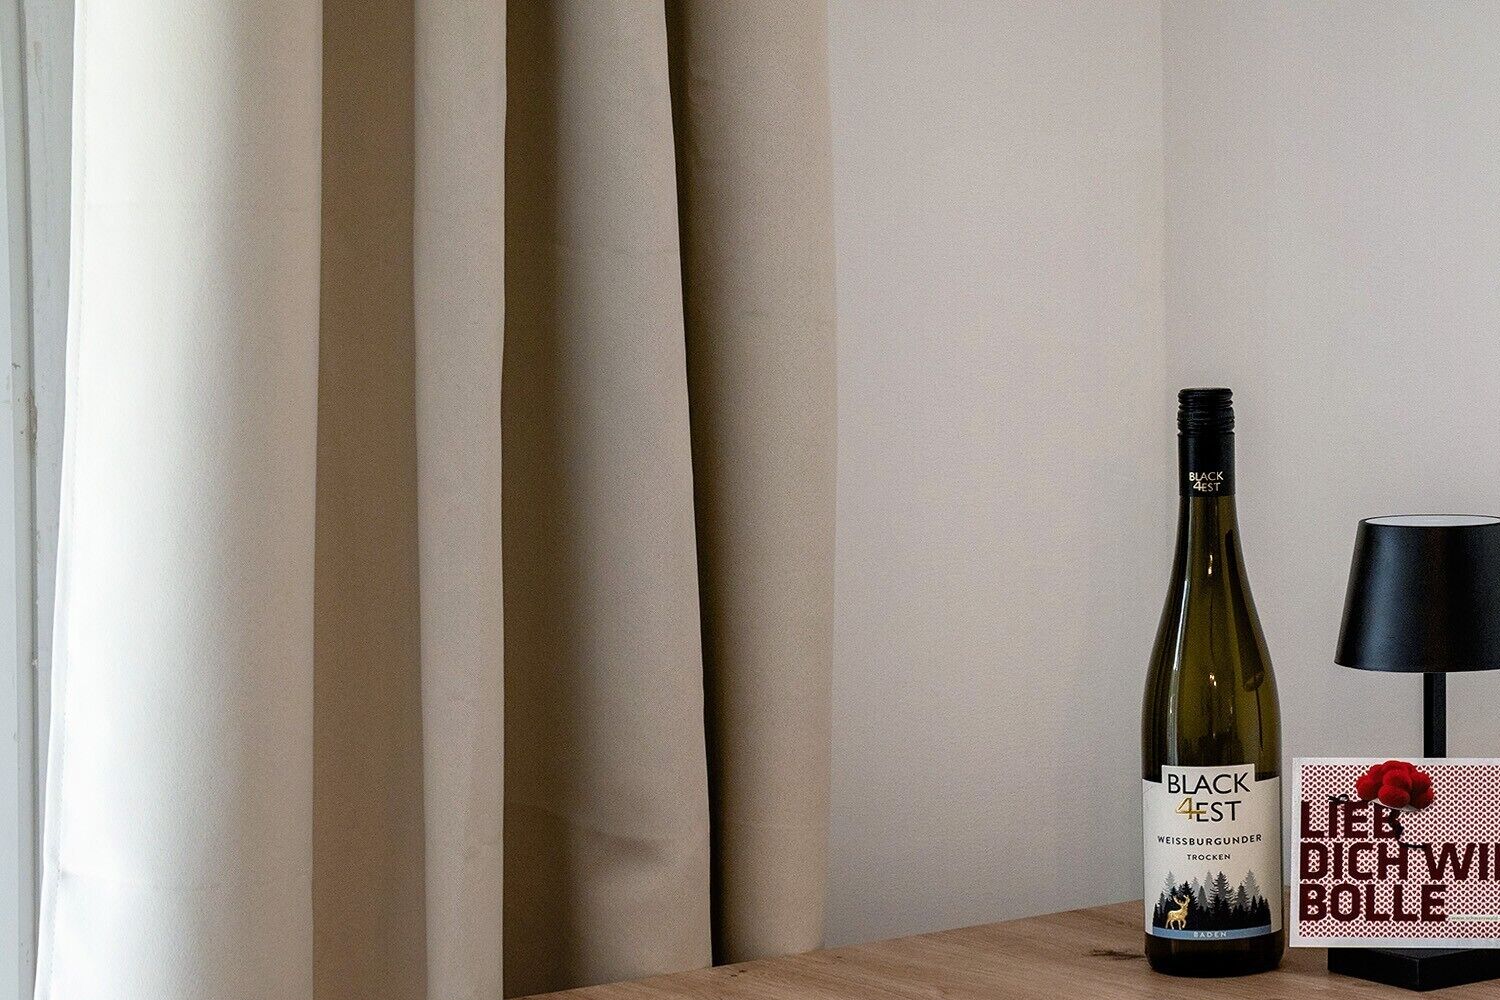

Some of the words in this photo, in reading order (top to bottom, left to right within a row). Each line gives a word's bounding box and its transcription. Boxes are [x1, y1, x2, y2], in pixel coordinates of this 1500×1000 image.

[1189, 471, 1224, 481] BLACK
[1193, 481, 1221, 492] 4EST
[1167, 773, 1250, 795] BLACK
[1175, 797, 1241, 822] 4EST
[1157, 833, 1262, 846] WEISSBURGUNDER
[1187, 853, 1231, 861] TROCKEN
[1300, 842, 1409, 880] DICH
[1299, 883, 1448, 922] BOLLE
